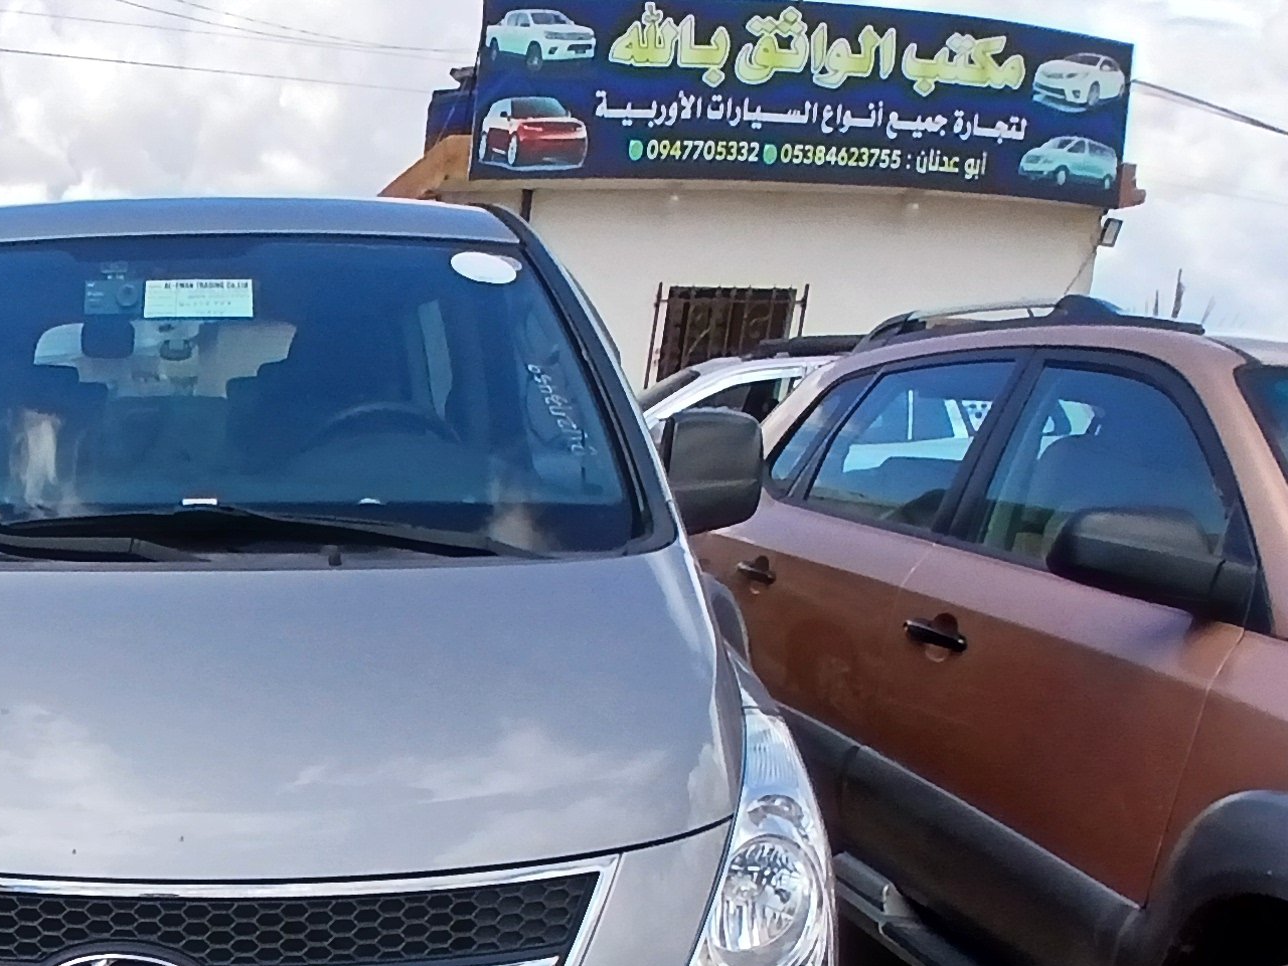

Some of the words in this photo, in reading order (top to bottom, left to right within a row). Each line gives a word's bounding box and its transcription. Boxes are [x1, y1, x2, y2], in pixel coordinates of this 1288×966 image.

[609, 2, 730, 87] بالله
[735, 6, 896, 88] الواثق
[901, 32, 1026, 96] مكتب
[595, 90, 703, 128] الأوربية
[707, 94, 819, 130] السيارات
[821, 101, 884, 133] أنواع
[886, 111, 948, 139] جميع
[953, 109, 1027, 144] لتجارة
[646, 139, 760, 163] 0947705332
[780, 143, 902, 169] 05384623755
[916, 149, 960, 173] عدنان
[964, 151, 988, 179] أبو
